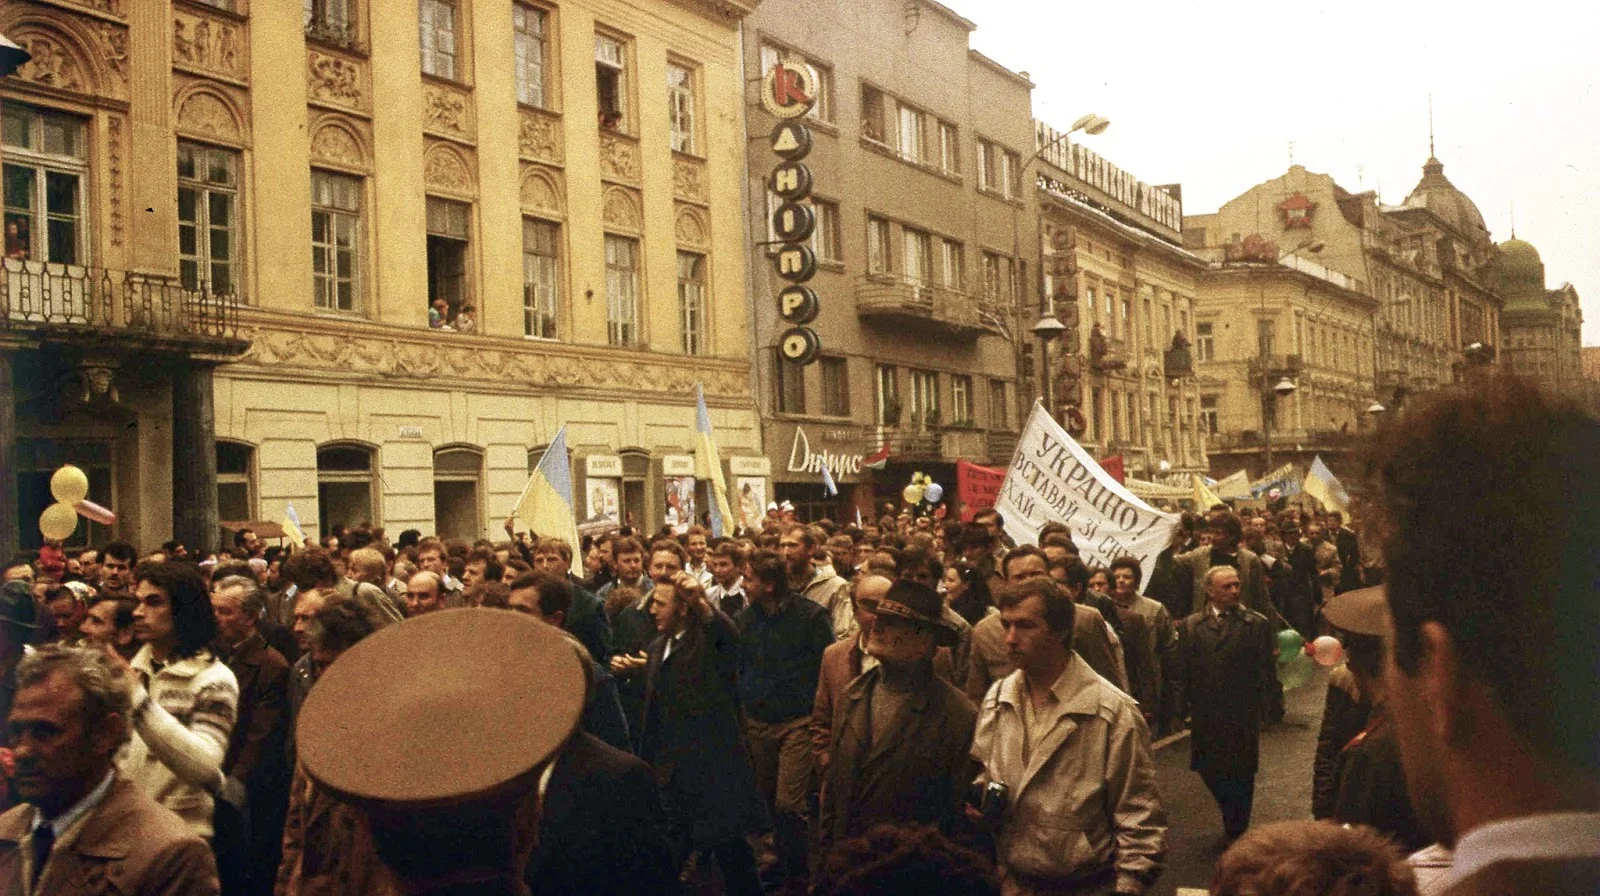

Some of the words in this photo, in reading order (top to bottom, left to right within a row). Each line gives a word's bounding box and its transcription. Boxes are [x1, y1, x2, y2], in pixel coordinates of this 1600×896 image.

[773, 127, 807, 358] ДНІПРО
[1002, 477, 1035, 518] ХАЙ
[1014, 451, 1079, 522] ВСТАВАЙ
[1078, 518, 1102, 541] ЗІ
